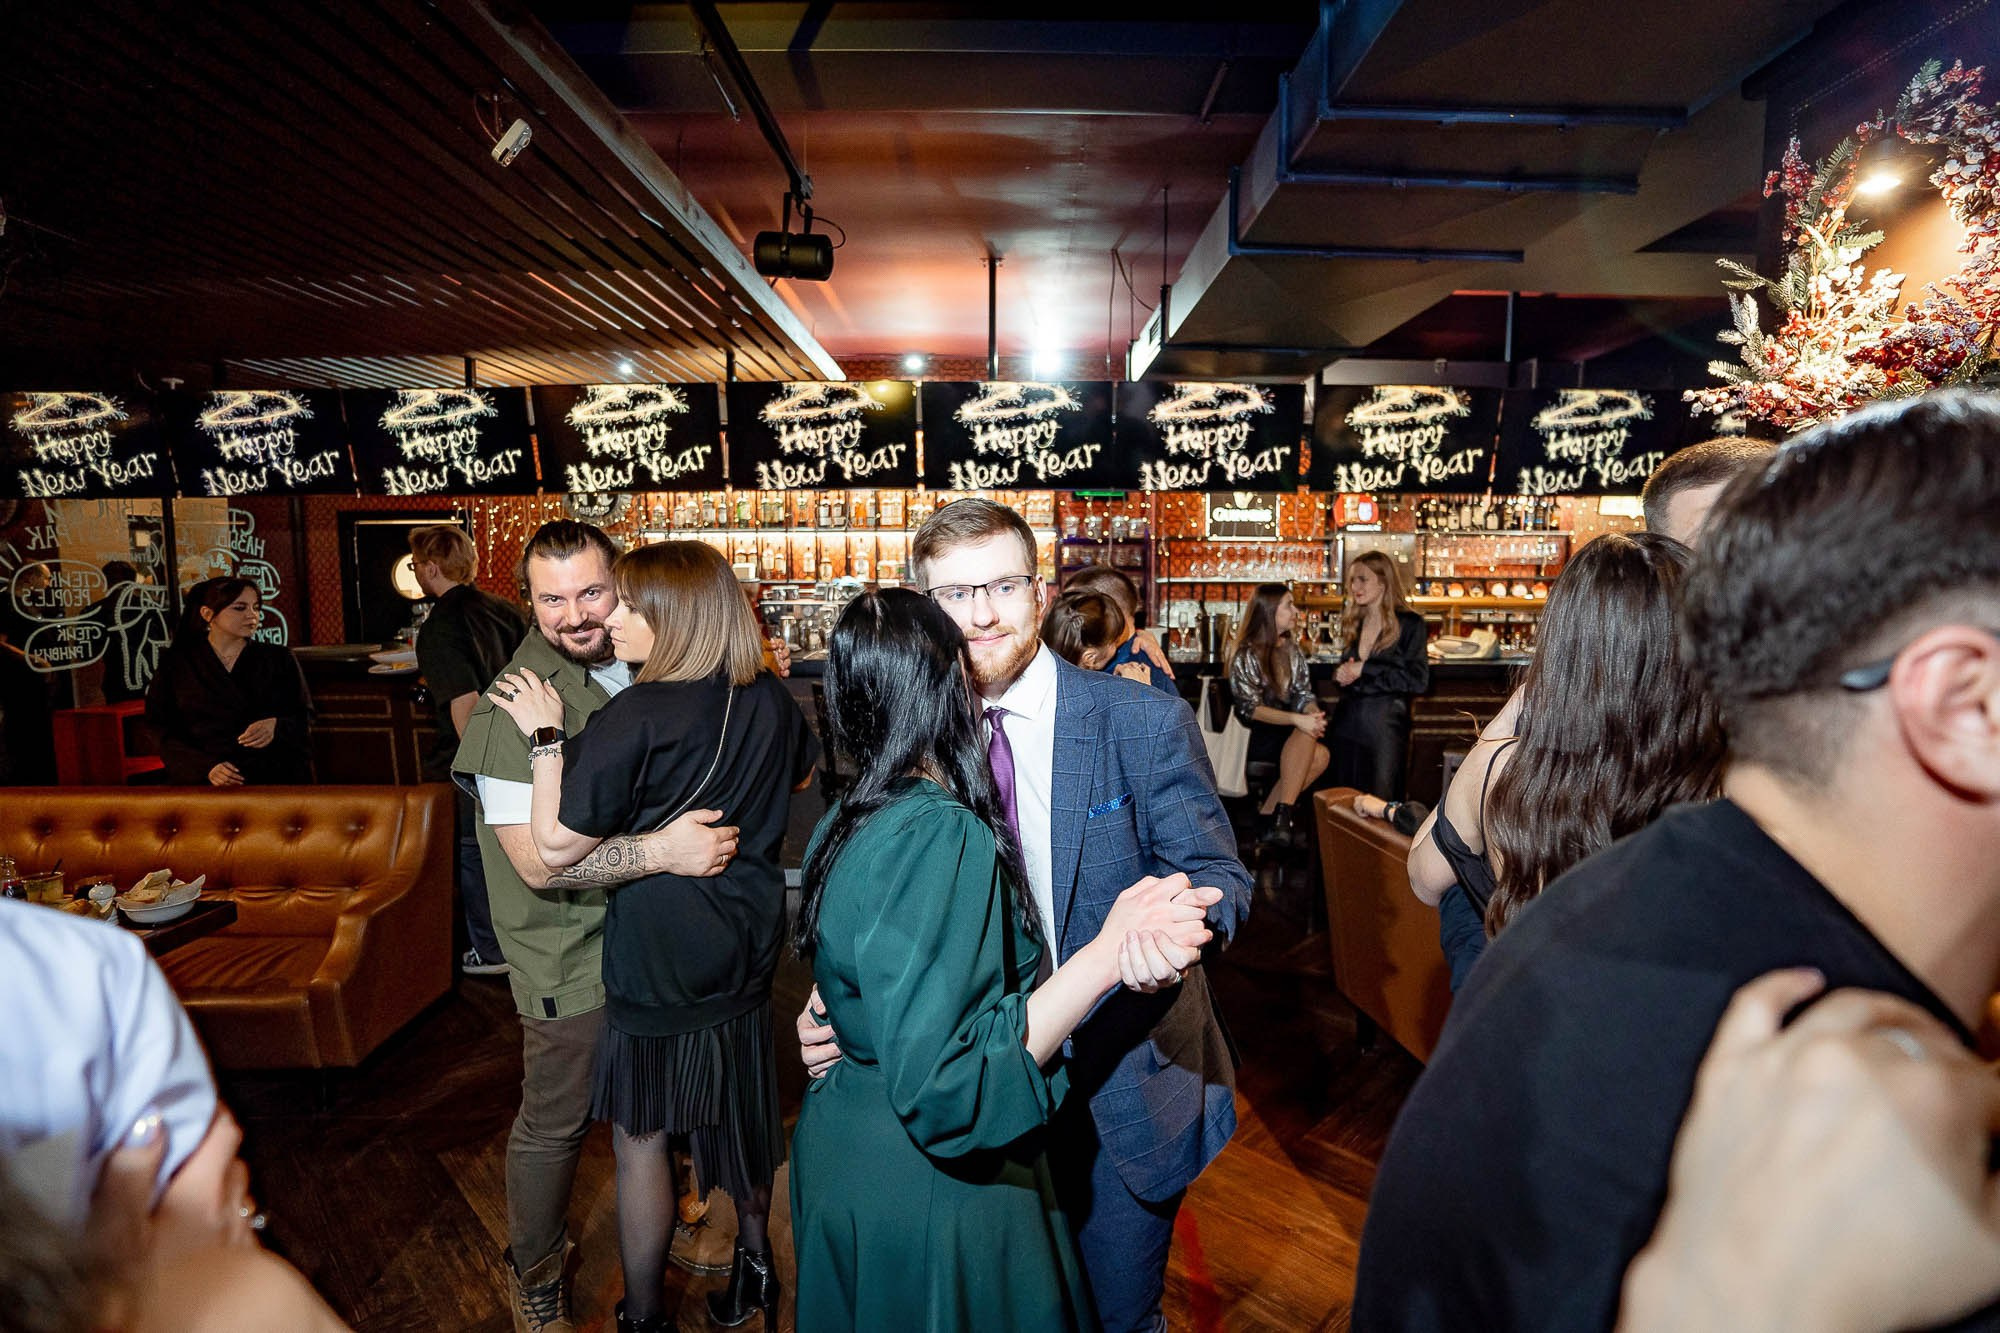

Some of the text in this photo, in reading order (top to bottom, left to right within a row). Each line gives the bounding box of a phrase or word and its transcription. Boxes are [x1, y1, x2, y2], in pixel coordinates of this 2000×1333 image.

[34, 429, 109, 463] Happy
[217, 428, 294, 462] Happy
[400, 427, 477, 461] Happy
[586, 422, 667, 456] Happy
[779, 420, 861, 454] Happy
[972, 420, 1057, 456] Happy
[1165, 422, 1250, 456] Happy
[1362, 424, 1445, 458] Happy
[1546, 428, 1627, 462] Happy
[18, 452, 157, 497] New Year
[203, 450, 339, 495] New Year
[384, 448, 522, 495] New Year
[567, 445, 711, 492] New Year
[758, 443, 906, 490] New Year
[951, 444, 1101, 490] New Year
[1141, 445, 1290, 491] New Year
[1337, 447, 1484, 493] New Year
[1519, 465, 1584, 495] New
